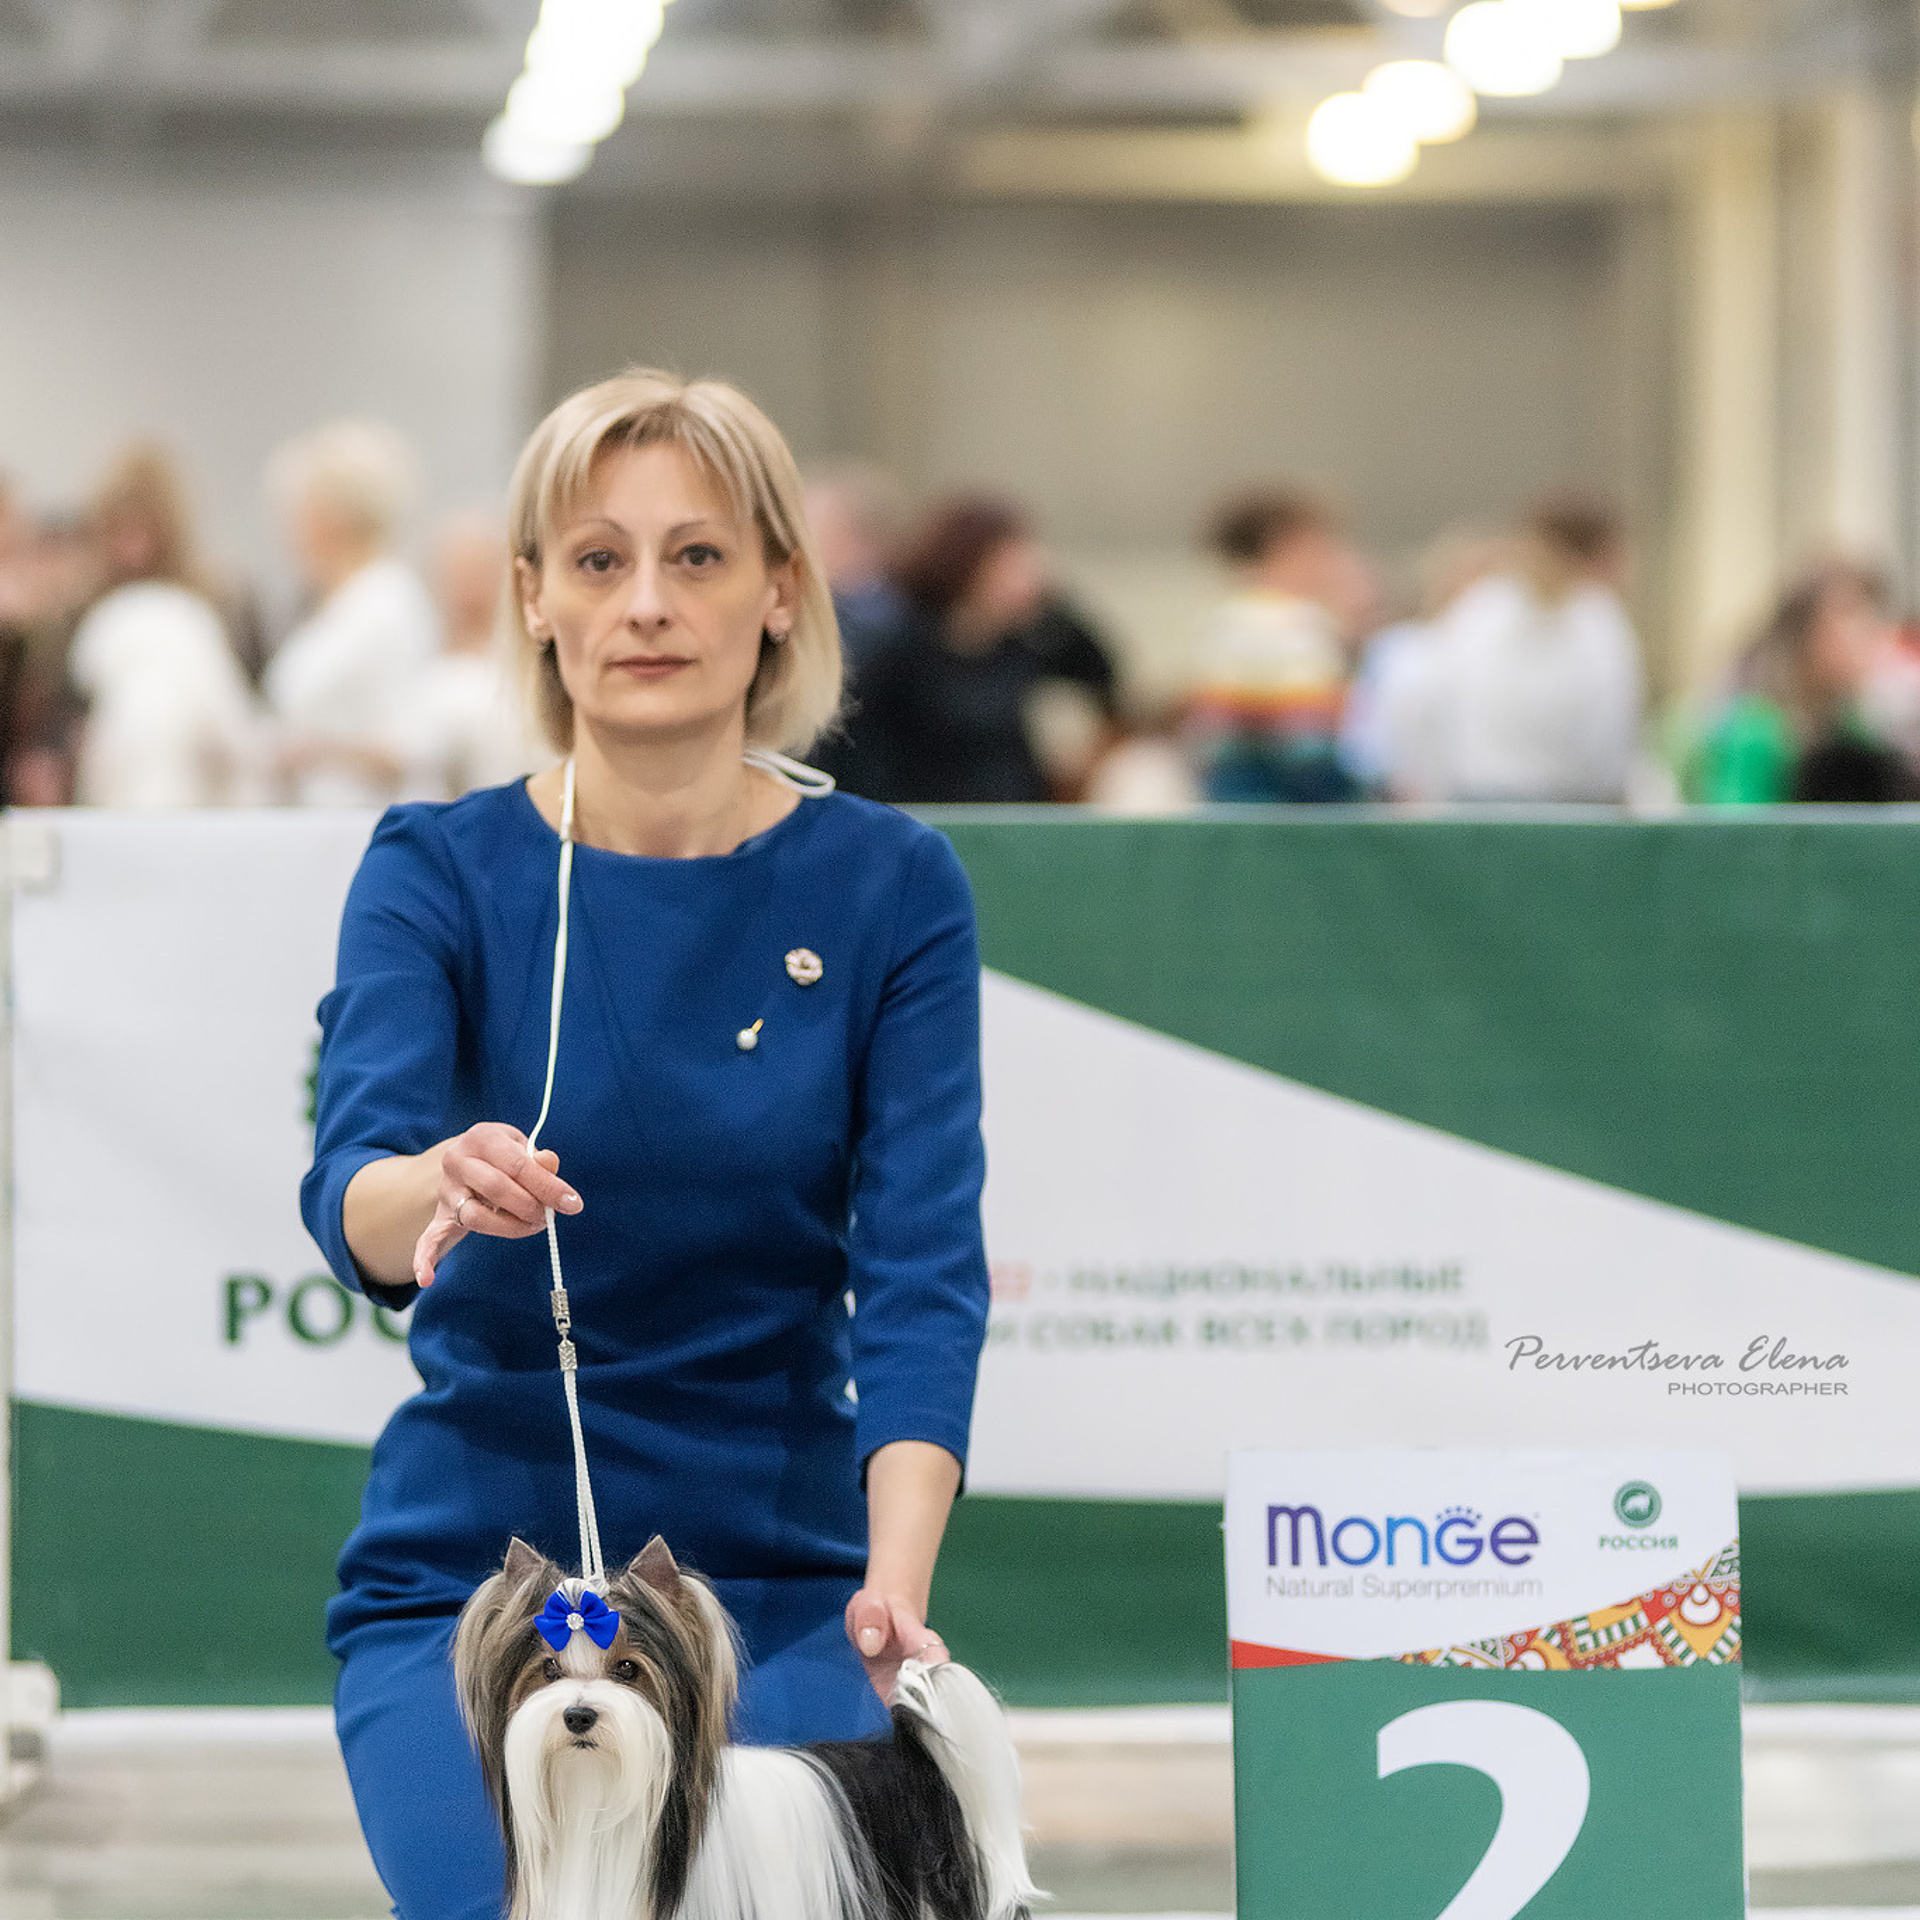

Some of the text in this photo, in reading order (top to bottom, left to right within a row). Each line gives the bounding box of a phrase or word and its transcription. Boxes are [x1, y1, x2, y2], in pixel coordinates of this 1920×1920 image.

[1598, 1535, 1679, 1550] РОССИЯ
[1266, 1574, 1544, 1600] Natural Superpremium
[1376, 1699, 1592, 1920] 2
